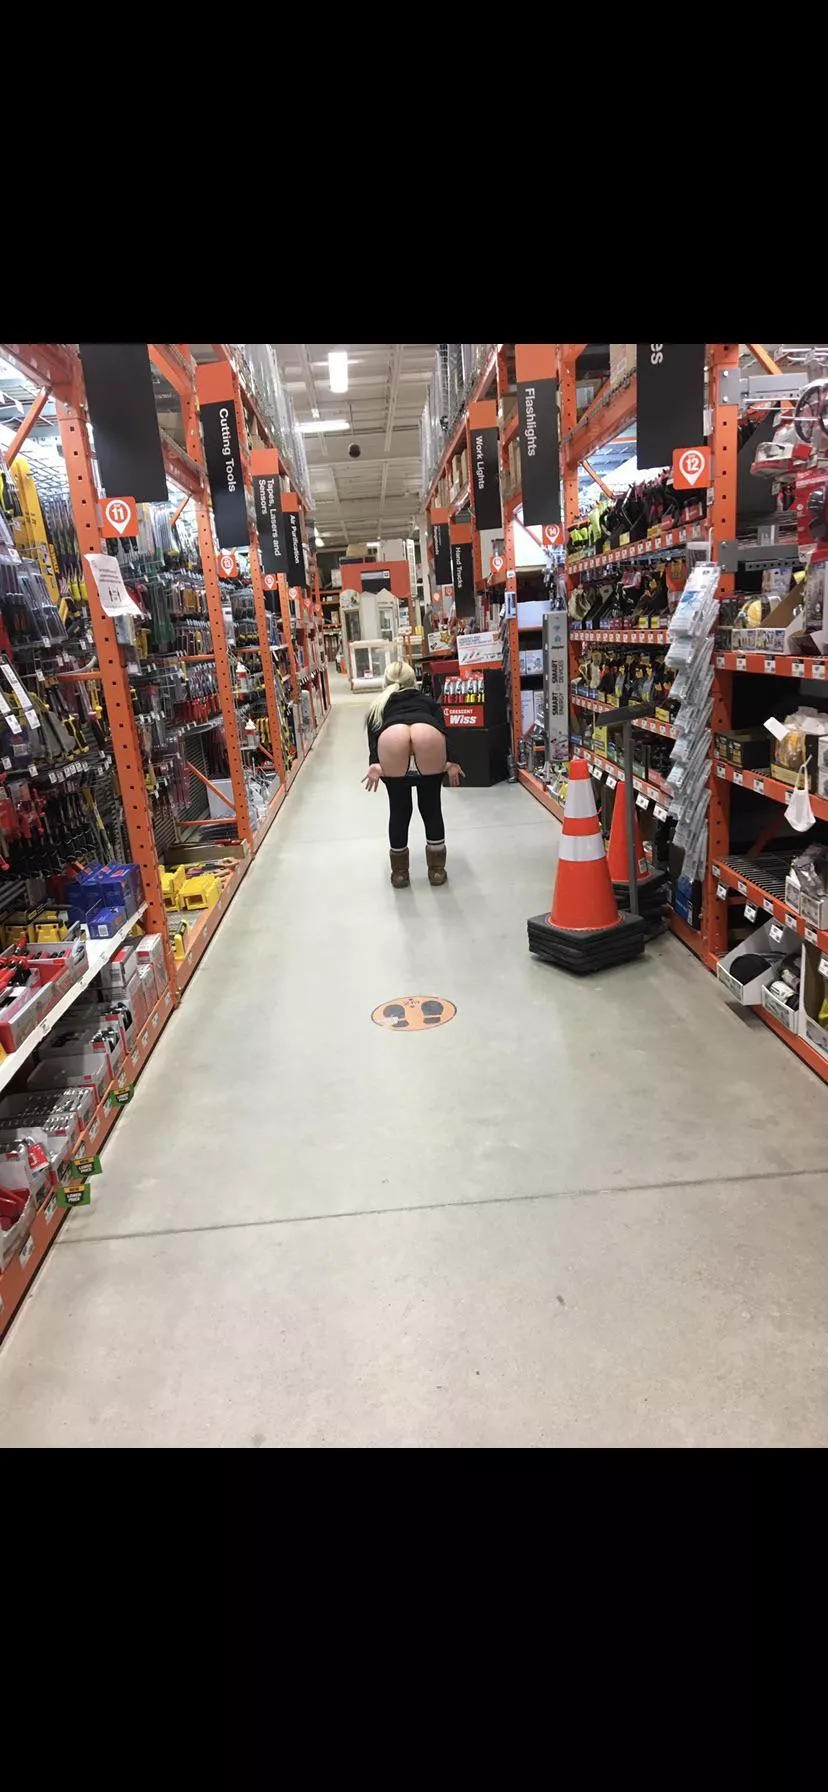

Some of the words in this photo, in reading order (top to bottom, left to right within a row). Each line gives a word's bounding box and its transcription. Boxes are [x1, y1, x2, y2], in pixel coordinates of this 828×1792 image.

[219, 407, 232, 456] Cutting
[524, 388, 537, 457] Flashlights
[475, 436, 483, 460] Work
[225, 458, 236, 493] Tools
[476, 461, 485, 490] Lights
[686, 458, 699, 471] 12
[258, 479, 268, 515] Sensors
[267, 478, 275, 507] Tapes,
[112, 507, 125, 521] 11
[269, 508, 278, 538] Lasers
[273, 540, 282, 557] and
[290, 526, 300, 564] Purification
[551, 660, 559, 684] SMART
[551, 692, 559, 716] SMART
[449, 715, 478, 725] Wiss
